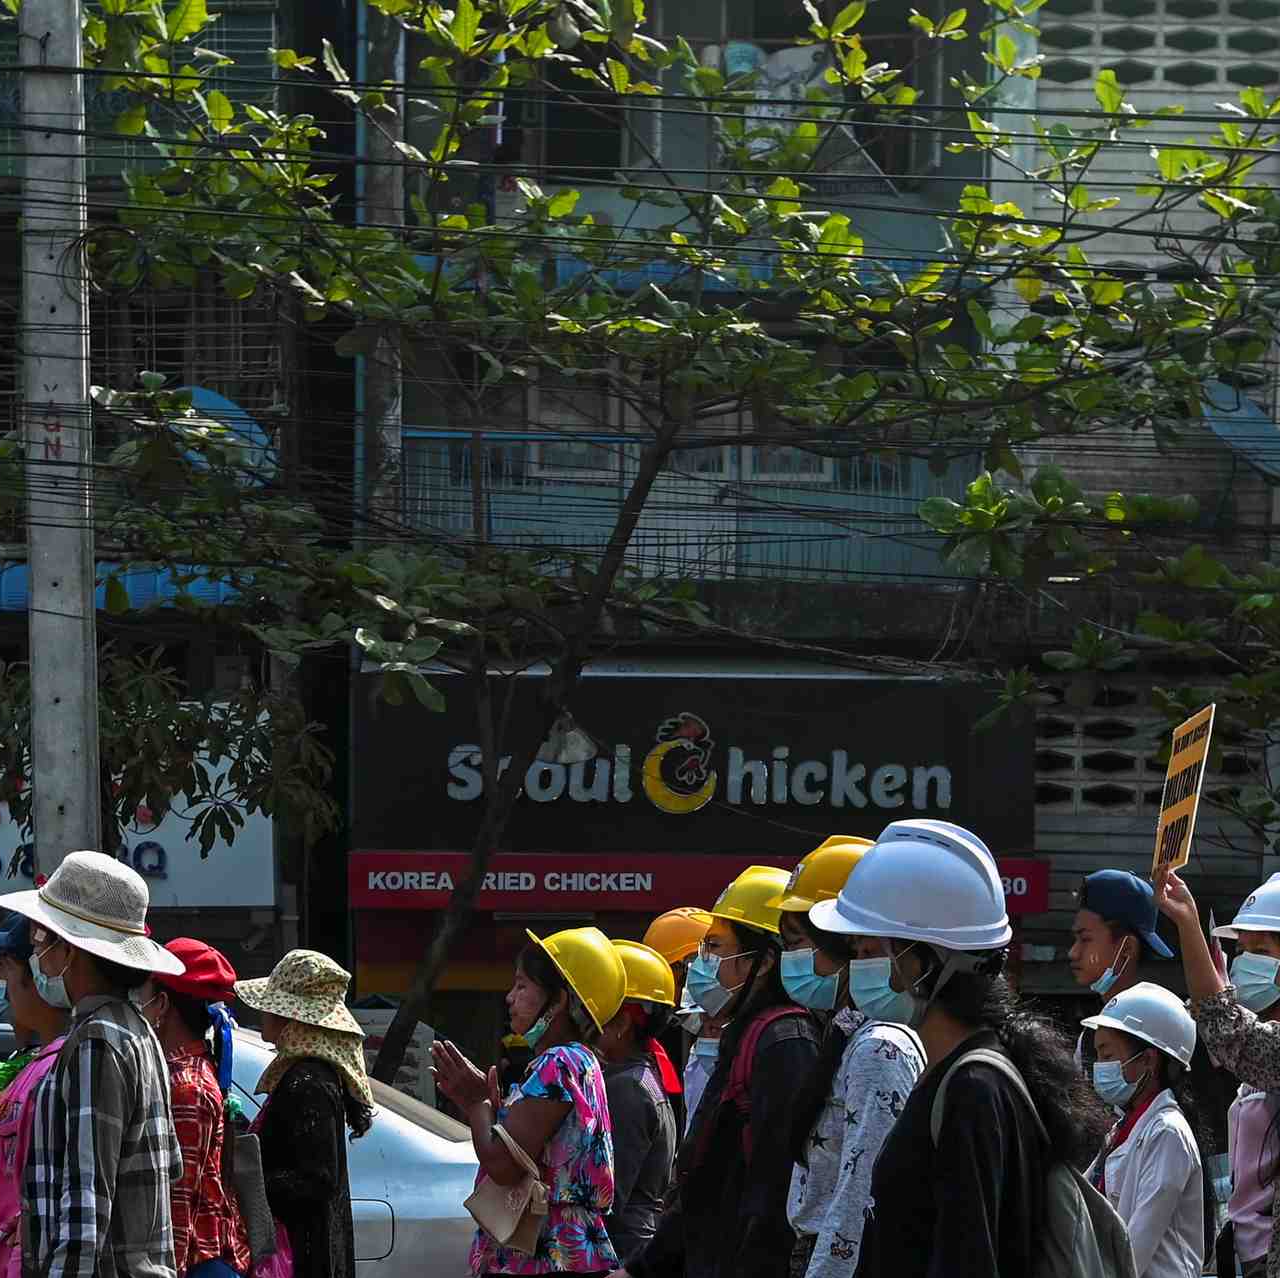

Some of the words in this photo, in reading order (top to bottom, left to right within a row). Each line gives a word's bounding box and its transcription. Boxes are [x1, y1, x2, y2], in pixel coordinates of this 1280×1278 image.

[368, 872, 454, 891] KOREA
[478, 872, 537, 891] RIED
[544, 872, 654, 891] CHICKEN
